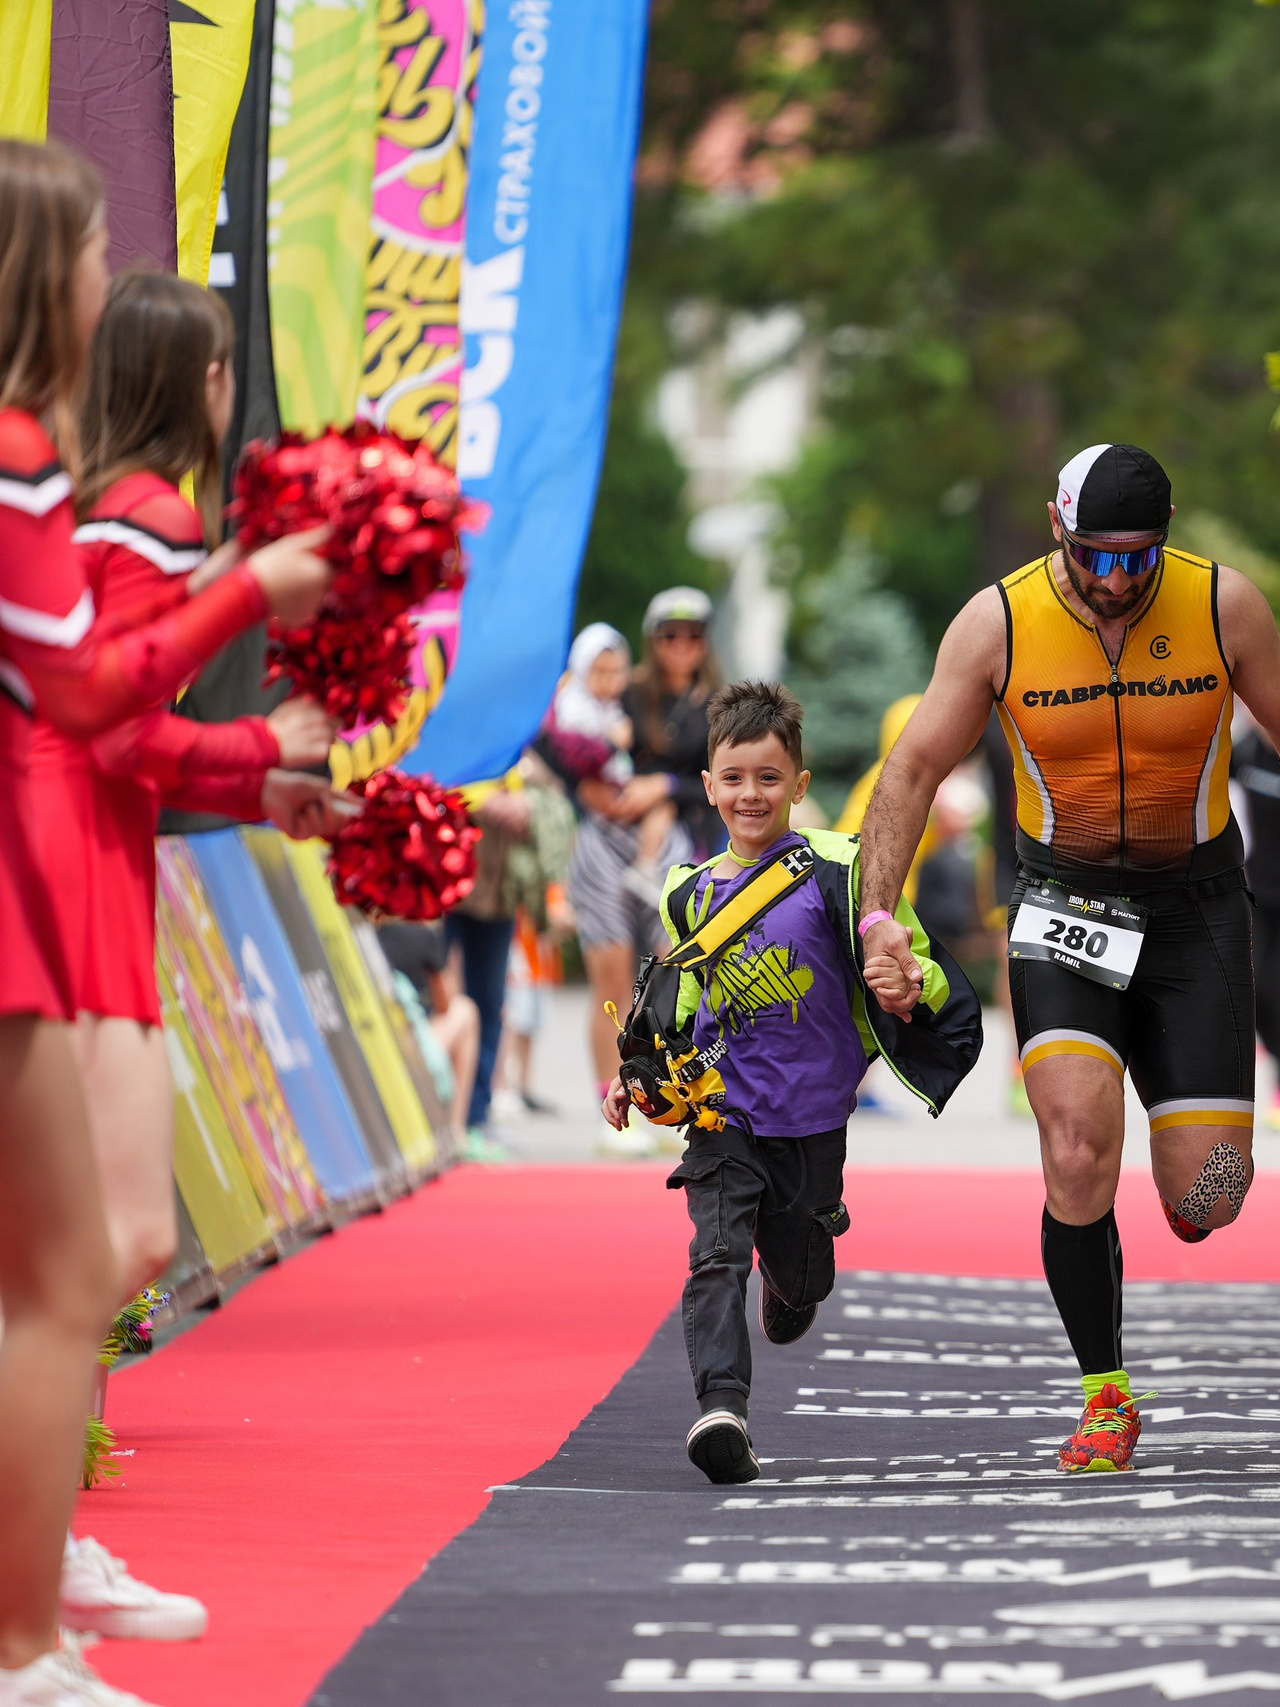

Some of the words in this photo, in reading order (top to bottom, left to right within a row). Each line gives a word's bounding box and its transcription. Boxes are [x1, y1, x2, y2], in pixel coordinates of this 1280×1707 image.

[1022, 674, 1219, 708] СТАВРОПОЛИС
[1068, 894, 1085, 907] IRON
[1090, 899, 1106, 912] STAR
[1117, 910, 1141, 922] МАГНИТ
[1042, 918, 1110, 959] 280
[1053, 951, 1082, 969] RAMIL
[794, 1403, 1086, 1417] IRON
[746, 1468, 1066, 1484] IRON
[721, 1491, 1062, 1507] IRON
[680, 1558, 1064, 1581] IRON
[621, 1658, 1063, 1687] IRON
